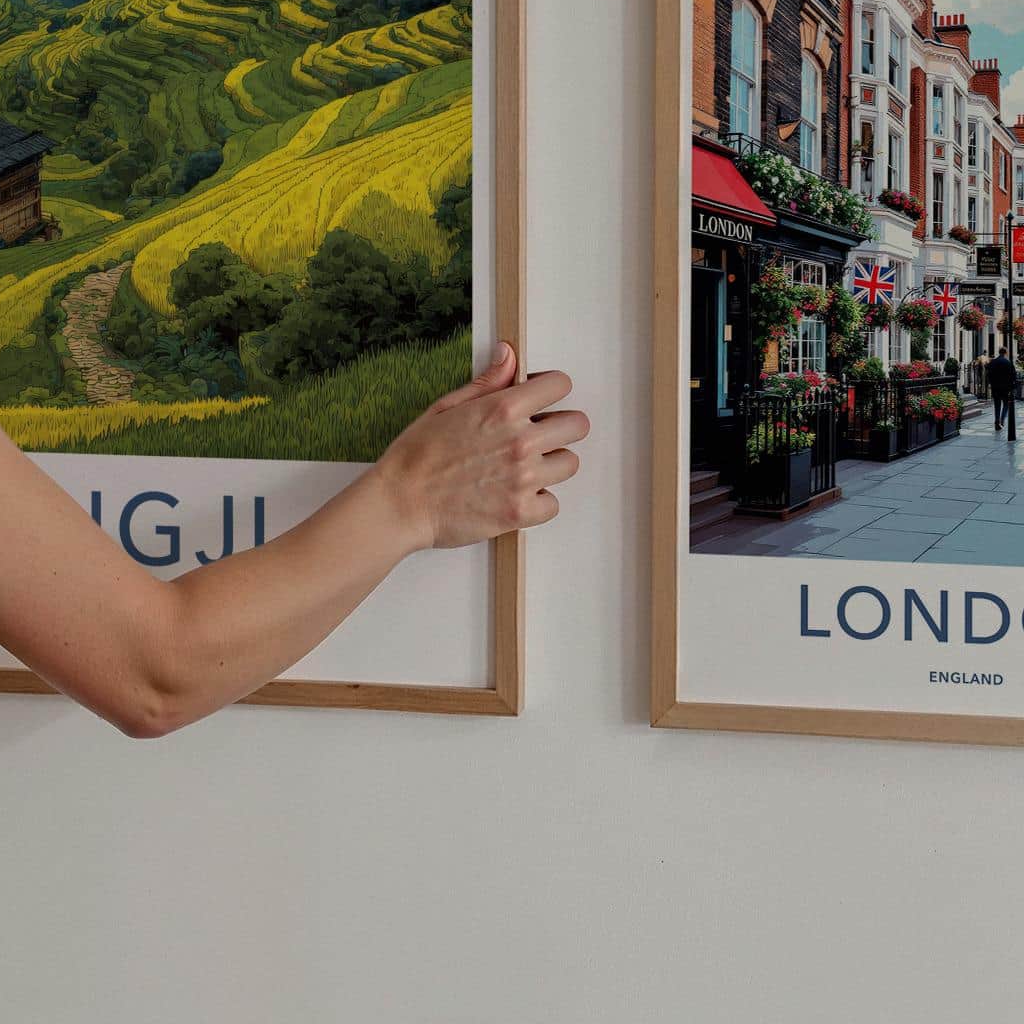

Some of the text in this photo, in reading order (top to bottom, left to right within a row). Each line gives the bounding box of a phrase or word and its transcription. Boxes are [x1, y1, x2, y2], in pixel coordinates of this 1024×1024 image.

[699, 214, 753, 242] LONDON
[800, 584, 1024, 645] LOND
[929, 671, 1004, 686] ENGLAND
